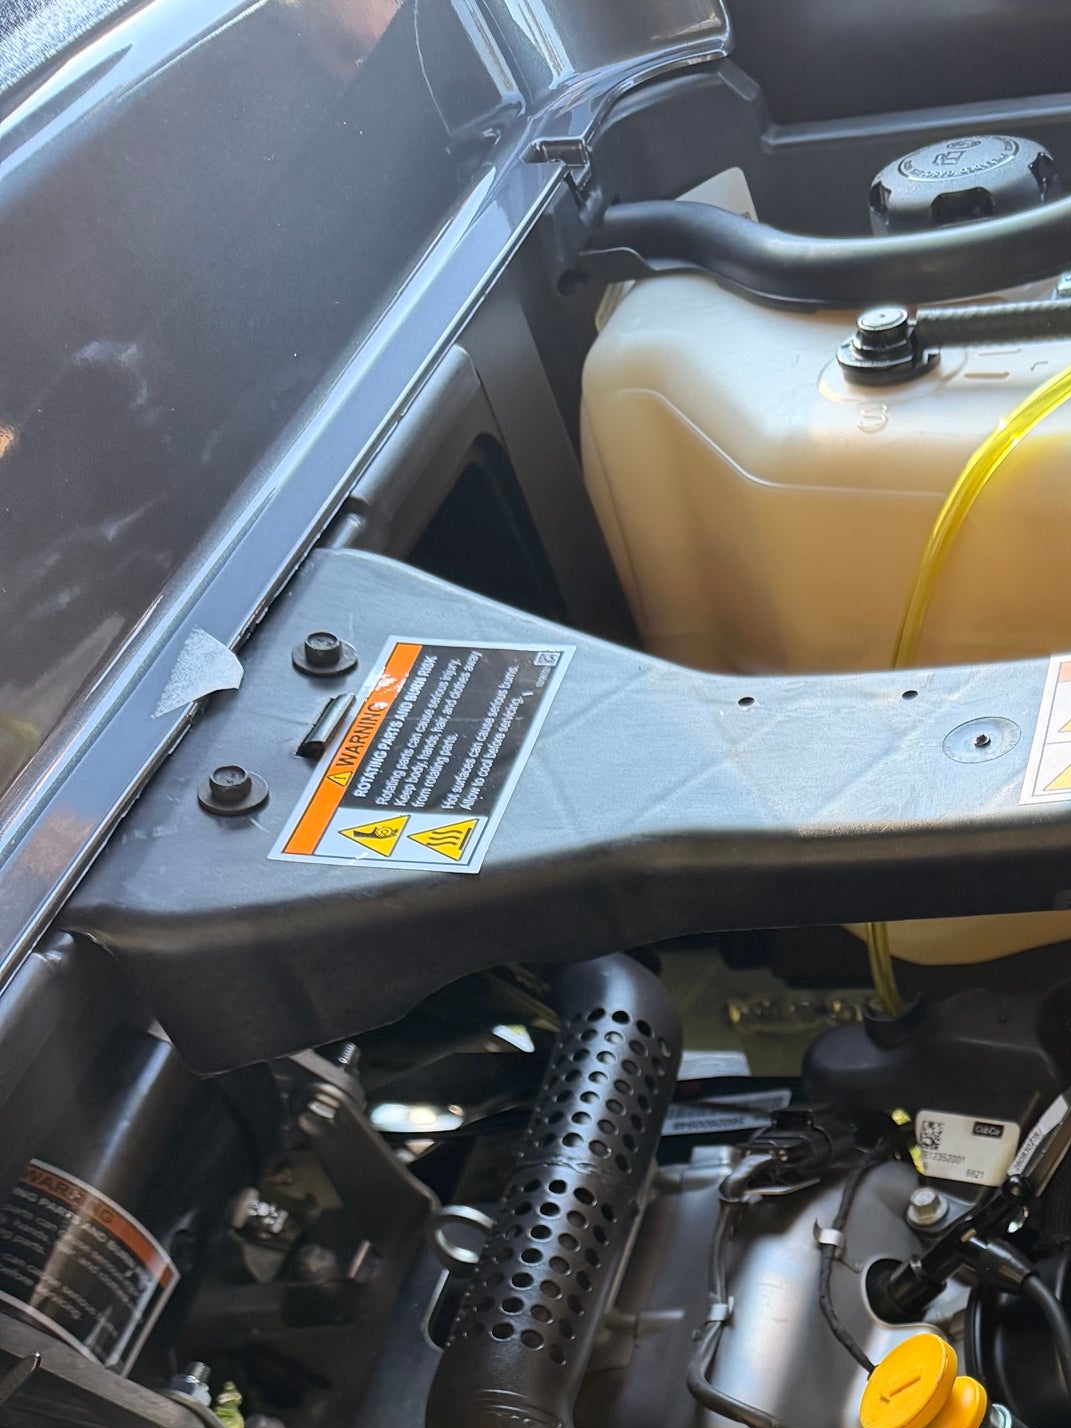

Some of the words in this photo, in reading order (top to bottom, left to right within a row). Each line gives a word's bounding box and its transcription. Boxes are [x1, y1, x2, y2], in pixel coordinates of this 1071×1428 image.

[353, 750, 386, 796] ROTATING
[377, 720, 402, 749] PARTS
[394, 701, 412, 721] AND
[404, 676, 426, 701] BURN
[417, 655, 437, 676] RISK
